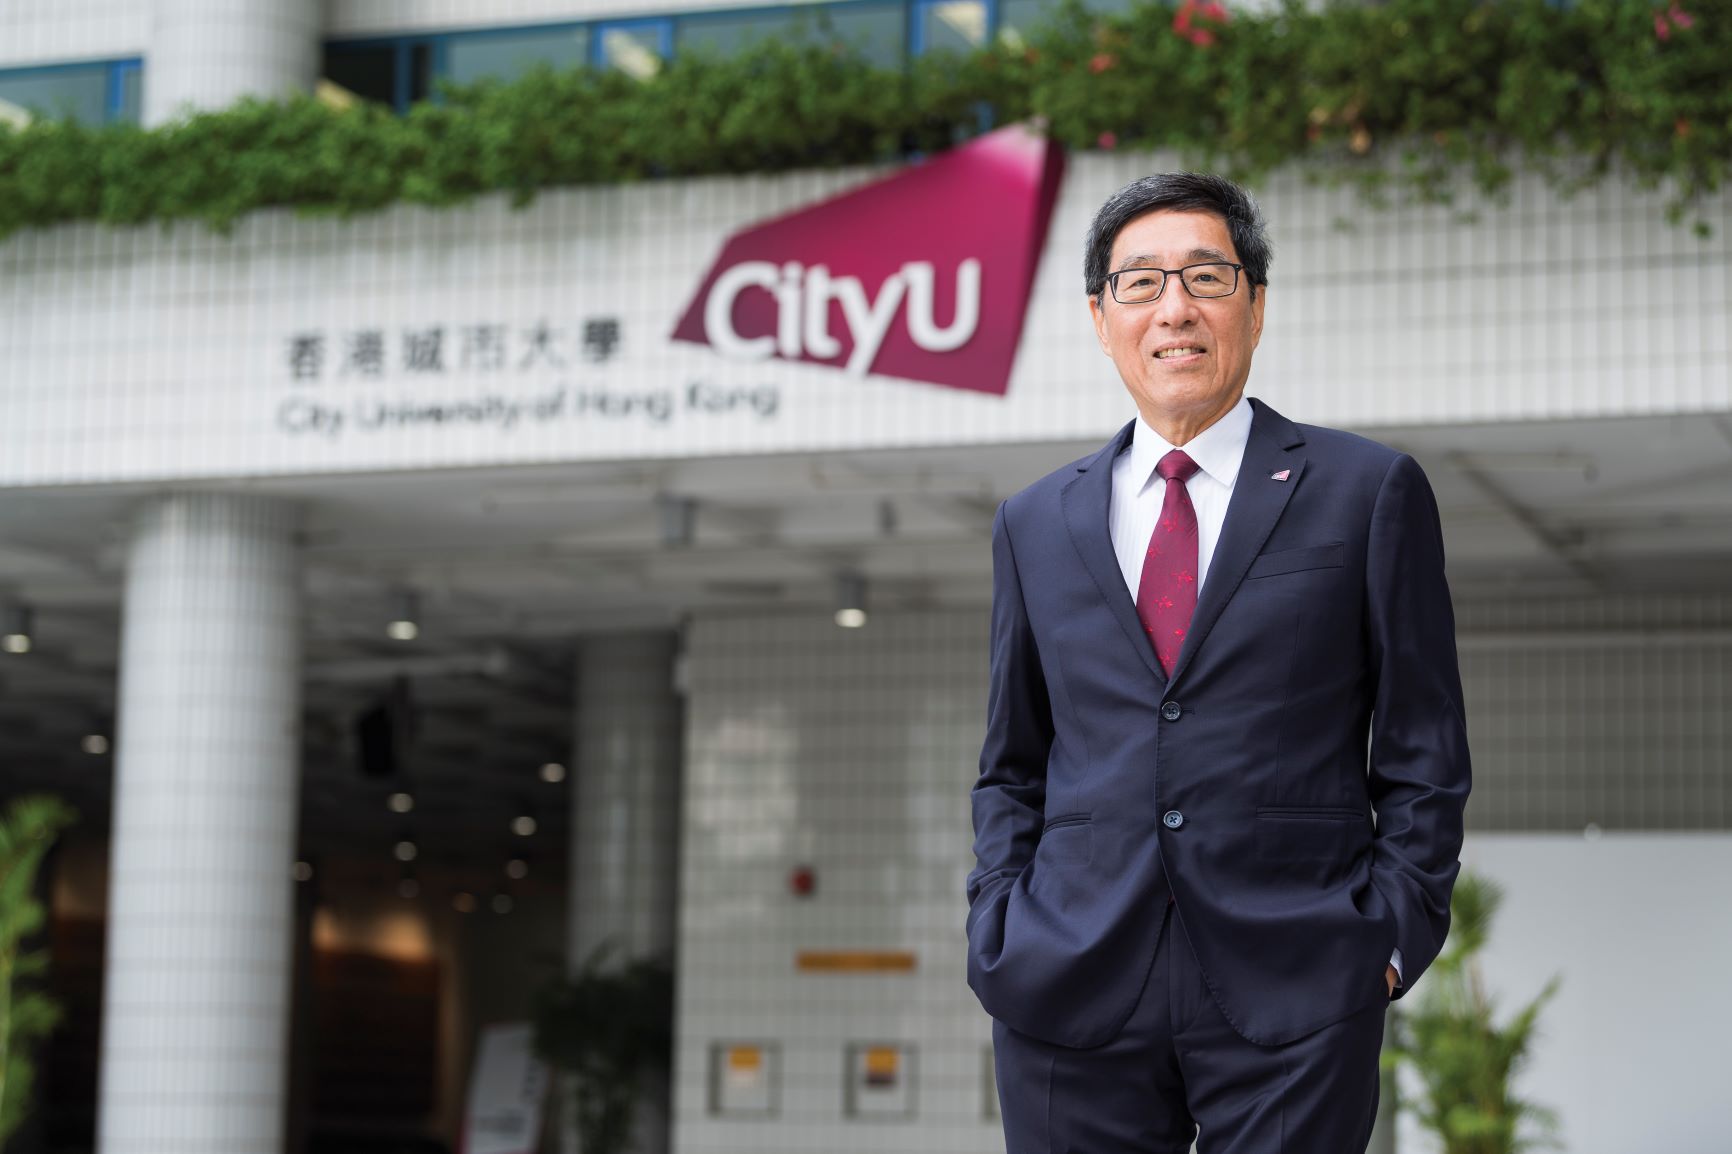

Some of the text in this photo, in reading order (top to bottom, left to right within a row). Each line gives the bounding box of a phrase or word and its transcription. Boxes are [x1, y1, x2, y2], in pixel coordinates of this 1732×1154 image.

[285, 315, 624, 382] 香港城市大學
[703, 257, 982, 377] CityU
[278, 380, 782, 439] City University of Hong Kong
